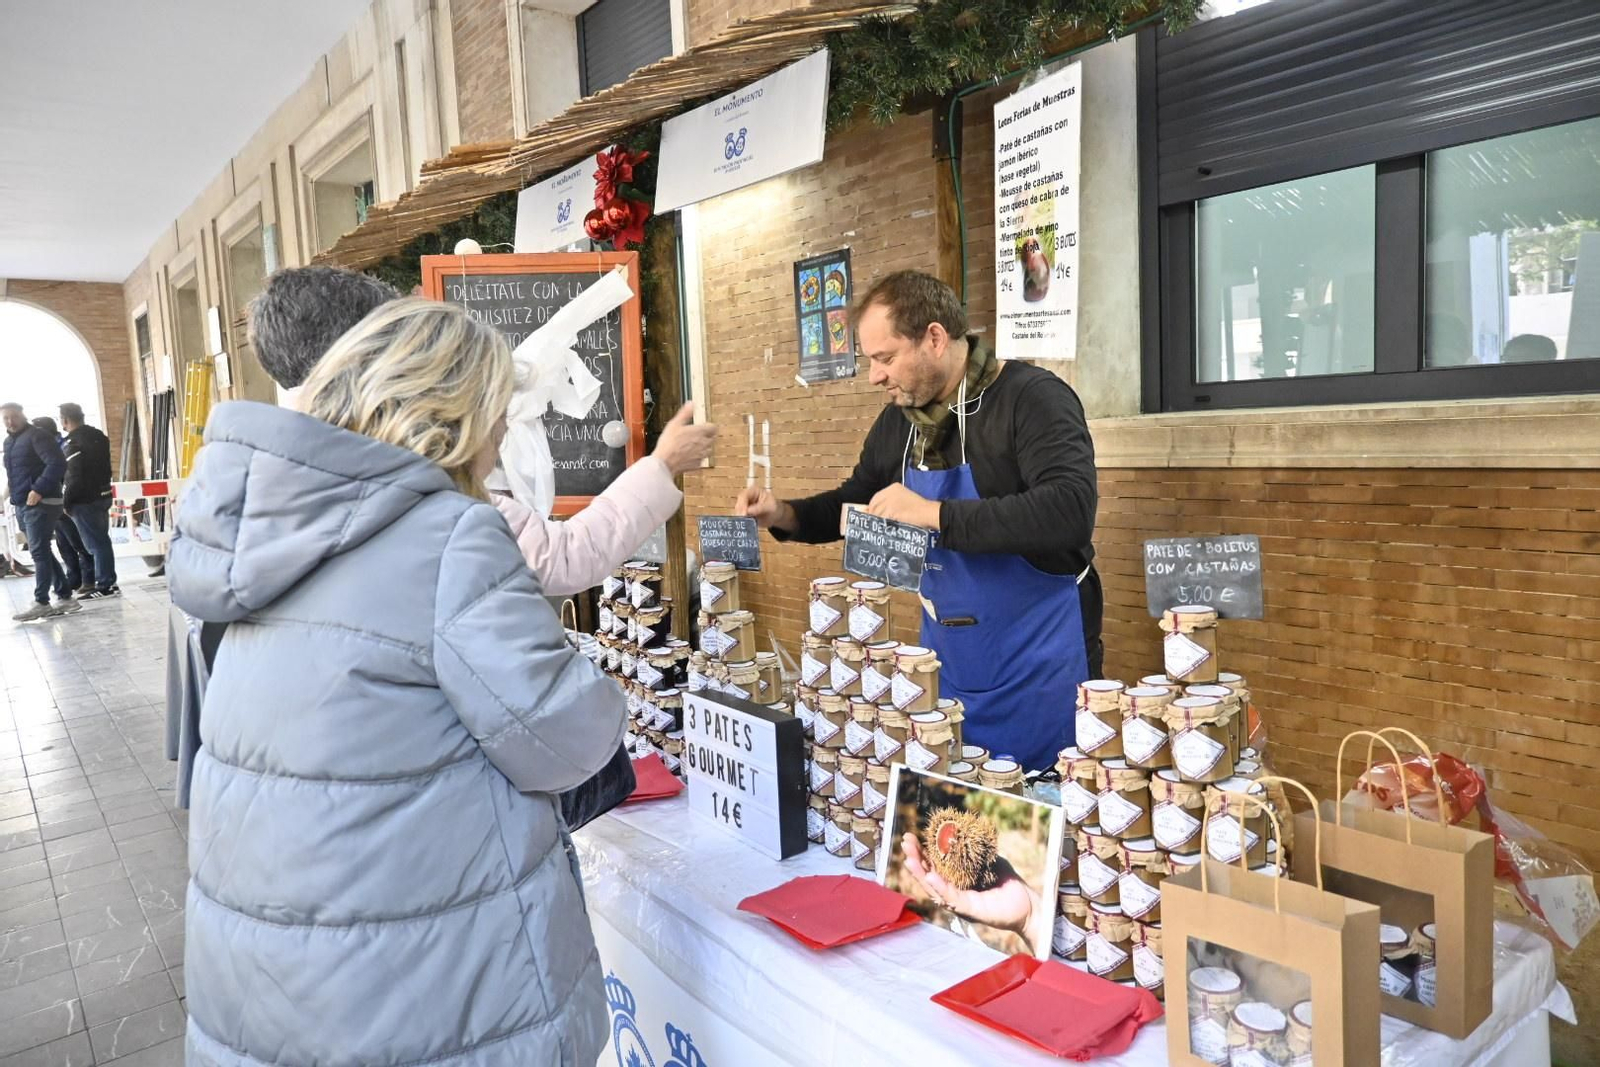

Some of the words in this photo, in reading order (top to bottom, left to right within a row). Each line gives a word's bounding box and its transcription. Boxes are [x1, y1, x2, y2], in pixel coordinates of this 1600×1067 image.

[714, 108, 721, 117] EL
[722, 88, 764, 113] MONUMENTO
[1013, 106, 1031, 122] Ferias
[1032, 101, 1040, 112] de
[1042, 86, 1075, 108] Muestras
[1014, 137, 1021, 148] de
[1022, 124, 1052, 144] castañas
[1054, 118, 1068, 130] con
[1024, 180, 1031, 190] de
[1032, 171, 1064, 187] castañas
[999, 204, 1010, 213] con
[1011, 198, 1028, 212] queso
[1030, 194, 1038, 204] de
[1040, 189, 1058, 202] cabra
[1060, 185, 1070, 196] de
[1000, 219, 1005, 228] la
[1006, 215, 1024, 227] Sierra
[1035, 224, 1044, 235] de
[1045, 222, 1059, 232] vino
[1000, 248, 1013, 256] tinto
[1054, 236, 1060, 250] 3
[532, 282, 560, 300] CON
[700, 520, 732, 530] MOUSSE
[736, 521, 746, 530] DE
[733, 530, 747, 538] CON
[872, 520, 883, 532] DE
[884, 526, 926, 546] CASTAÑAS
[702, 538, 726, 548] QUESO
[1176, 544, 1192, 558] DE
[1205, 541, 1257, 554] BOLETUS
[1147, 564, 1176, 574] CON
[1185, 558, 1256, 576] CASTAÑAS
[1177, 586, 1212, 604] 5,00
[688, 704, 696, 730] 3
[704, 708, 752, 752] PATES
[688, 743, 759, 796] GOURMET
[712, 792, 743, 829] 14€
